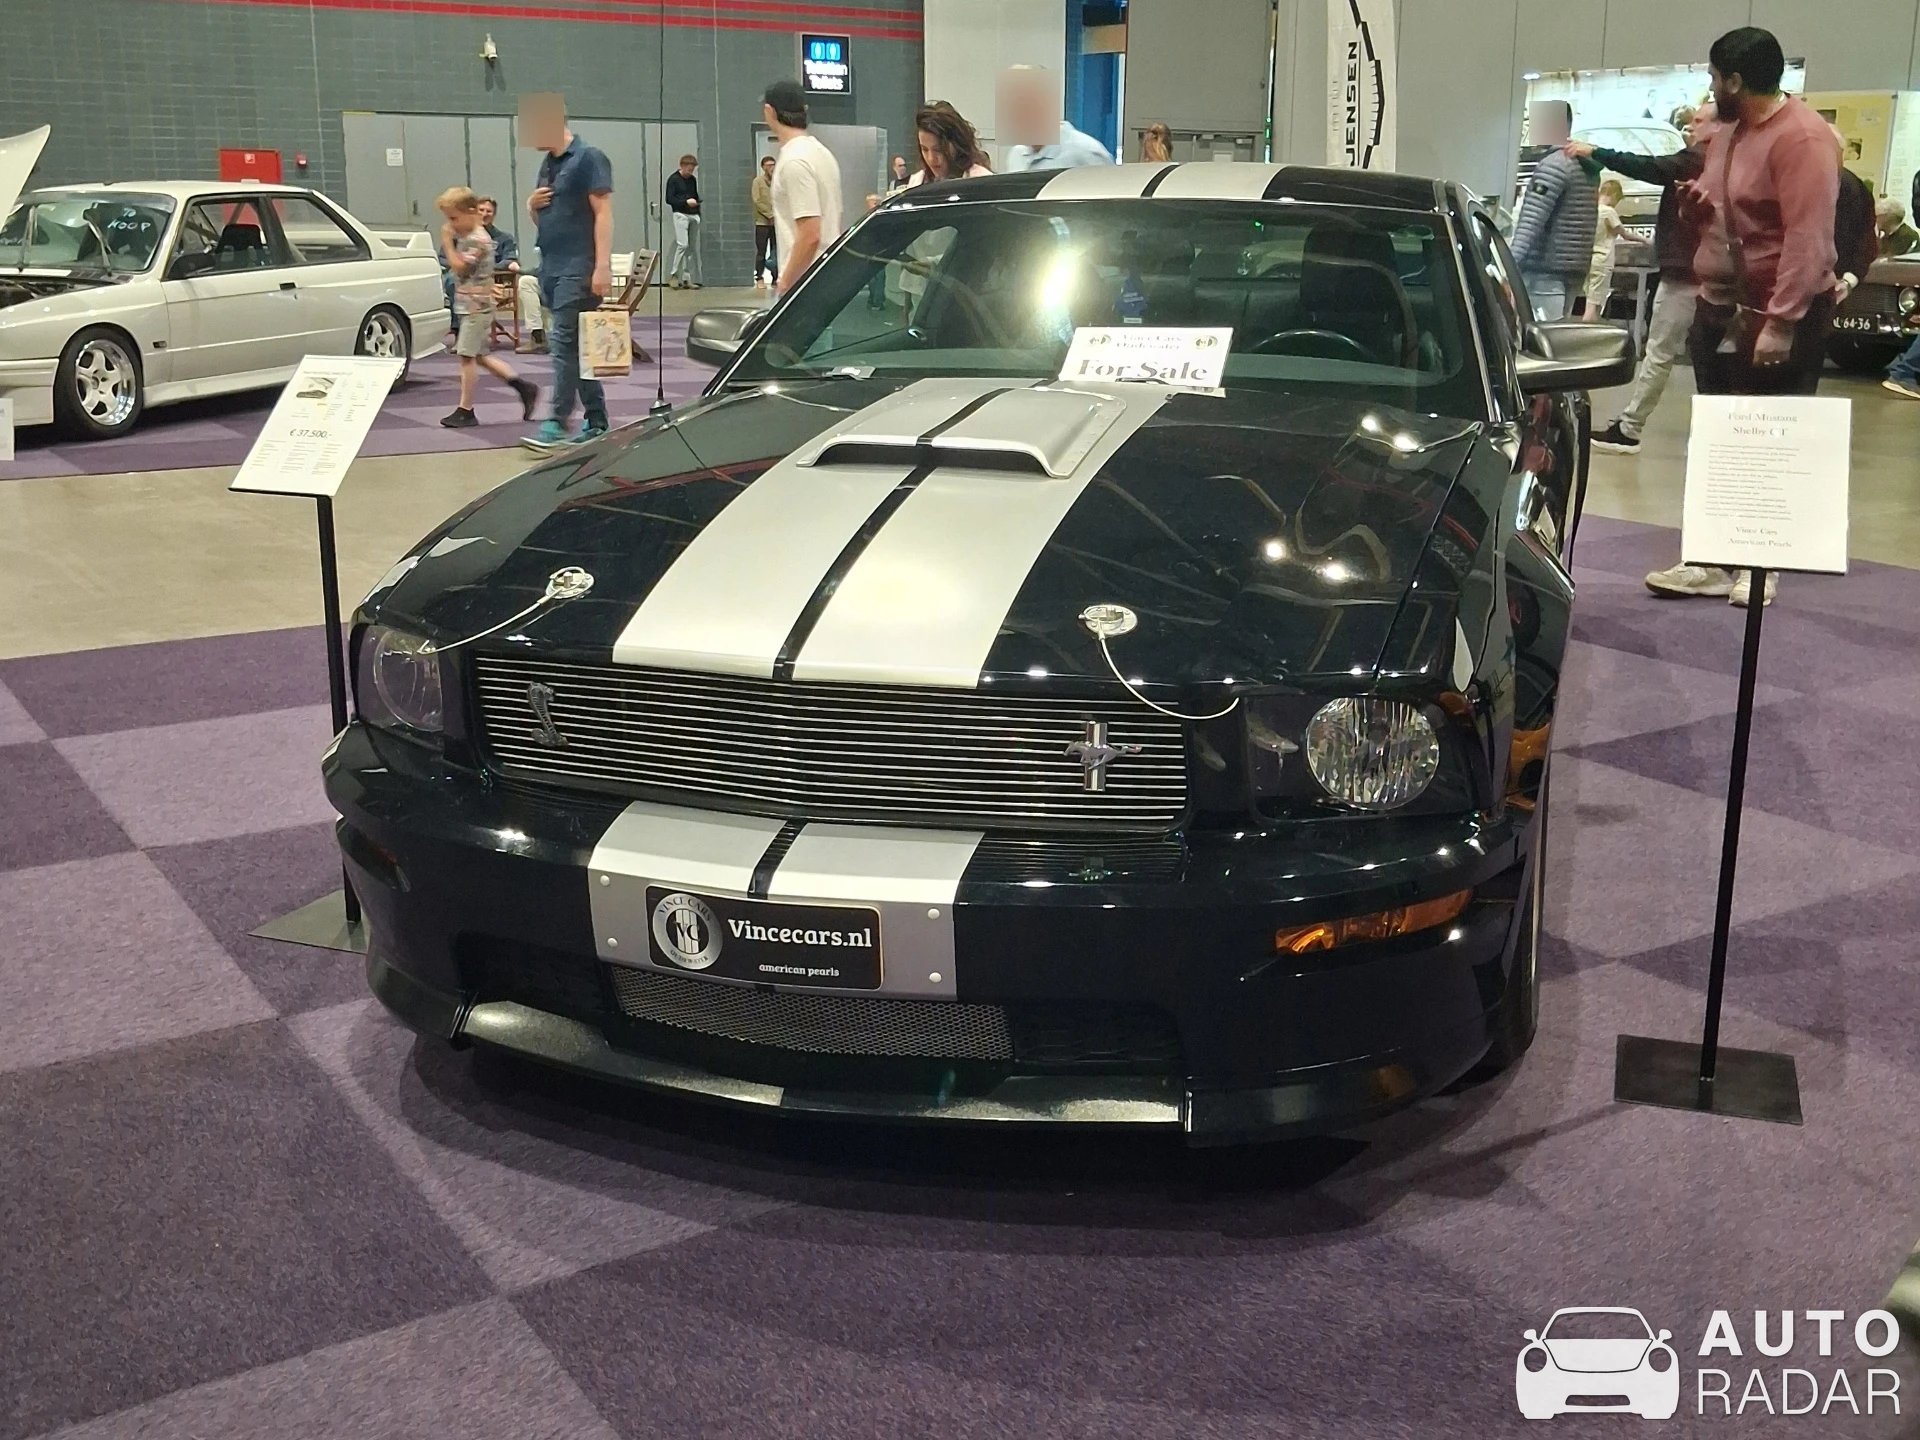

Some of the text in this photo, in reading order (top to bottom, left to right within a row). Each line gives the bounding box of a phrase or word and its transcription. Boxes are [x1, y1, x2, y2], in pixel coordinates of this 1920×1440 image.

[1345, 41, 1358, 167] JENSEN
[1078, 359, 1208, 381] For Sale
[1728, 412, 1799, 423] Ford Mustang
[1732, 426, 1767, 437] Shelby
[659, 896, 685, 914] VINCE
[727, 917, 873, 949] Vincecars.nl
[758, 962, 840, 978] american pearls
